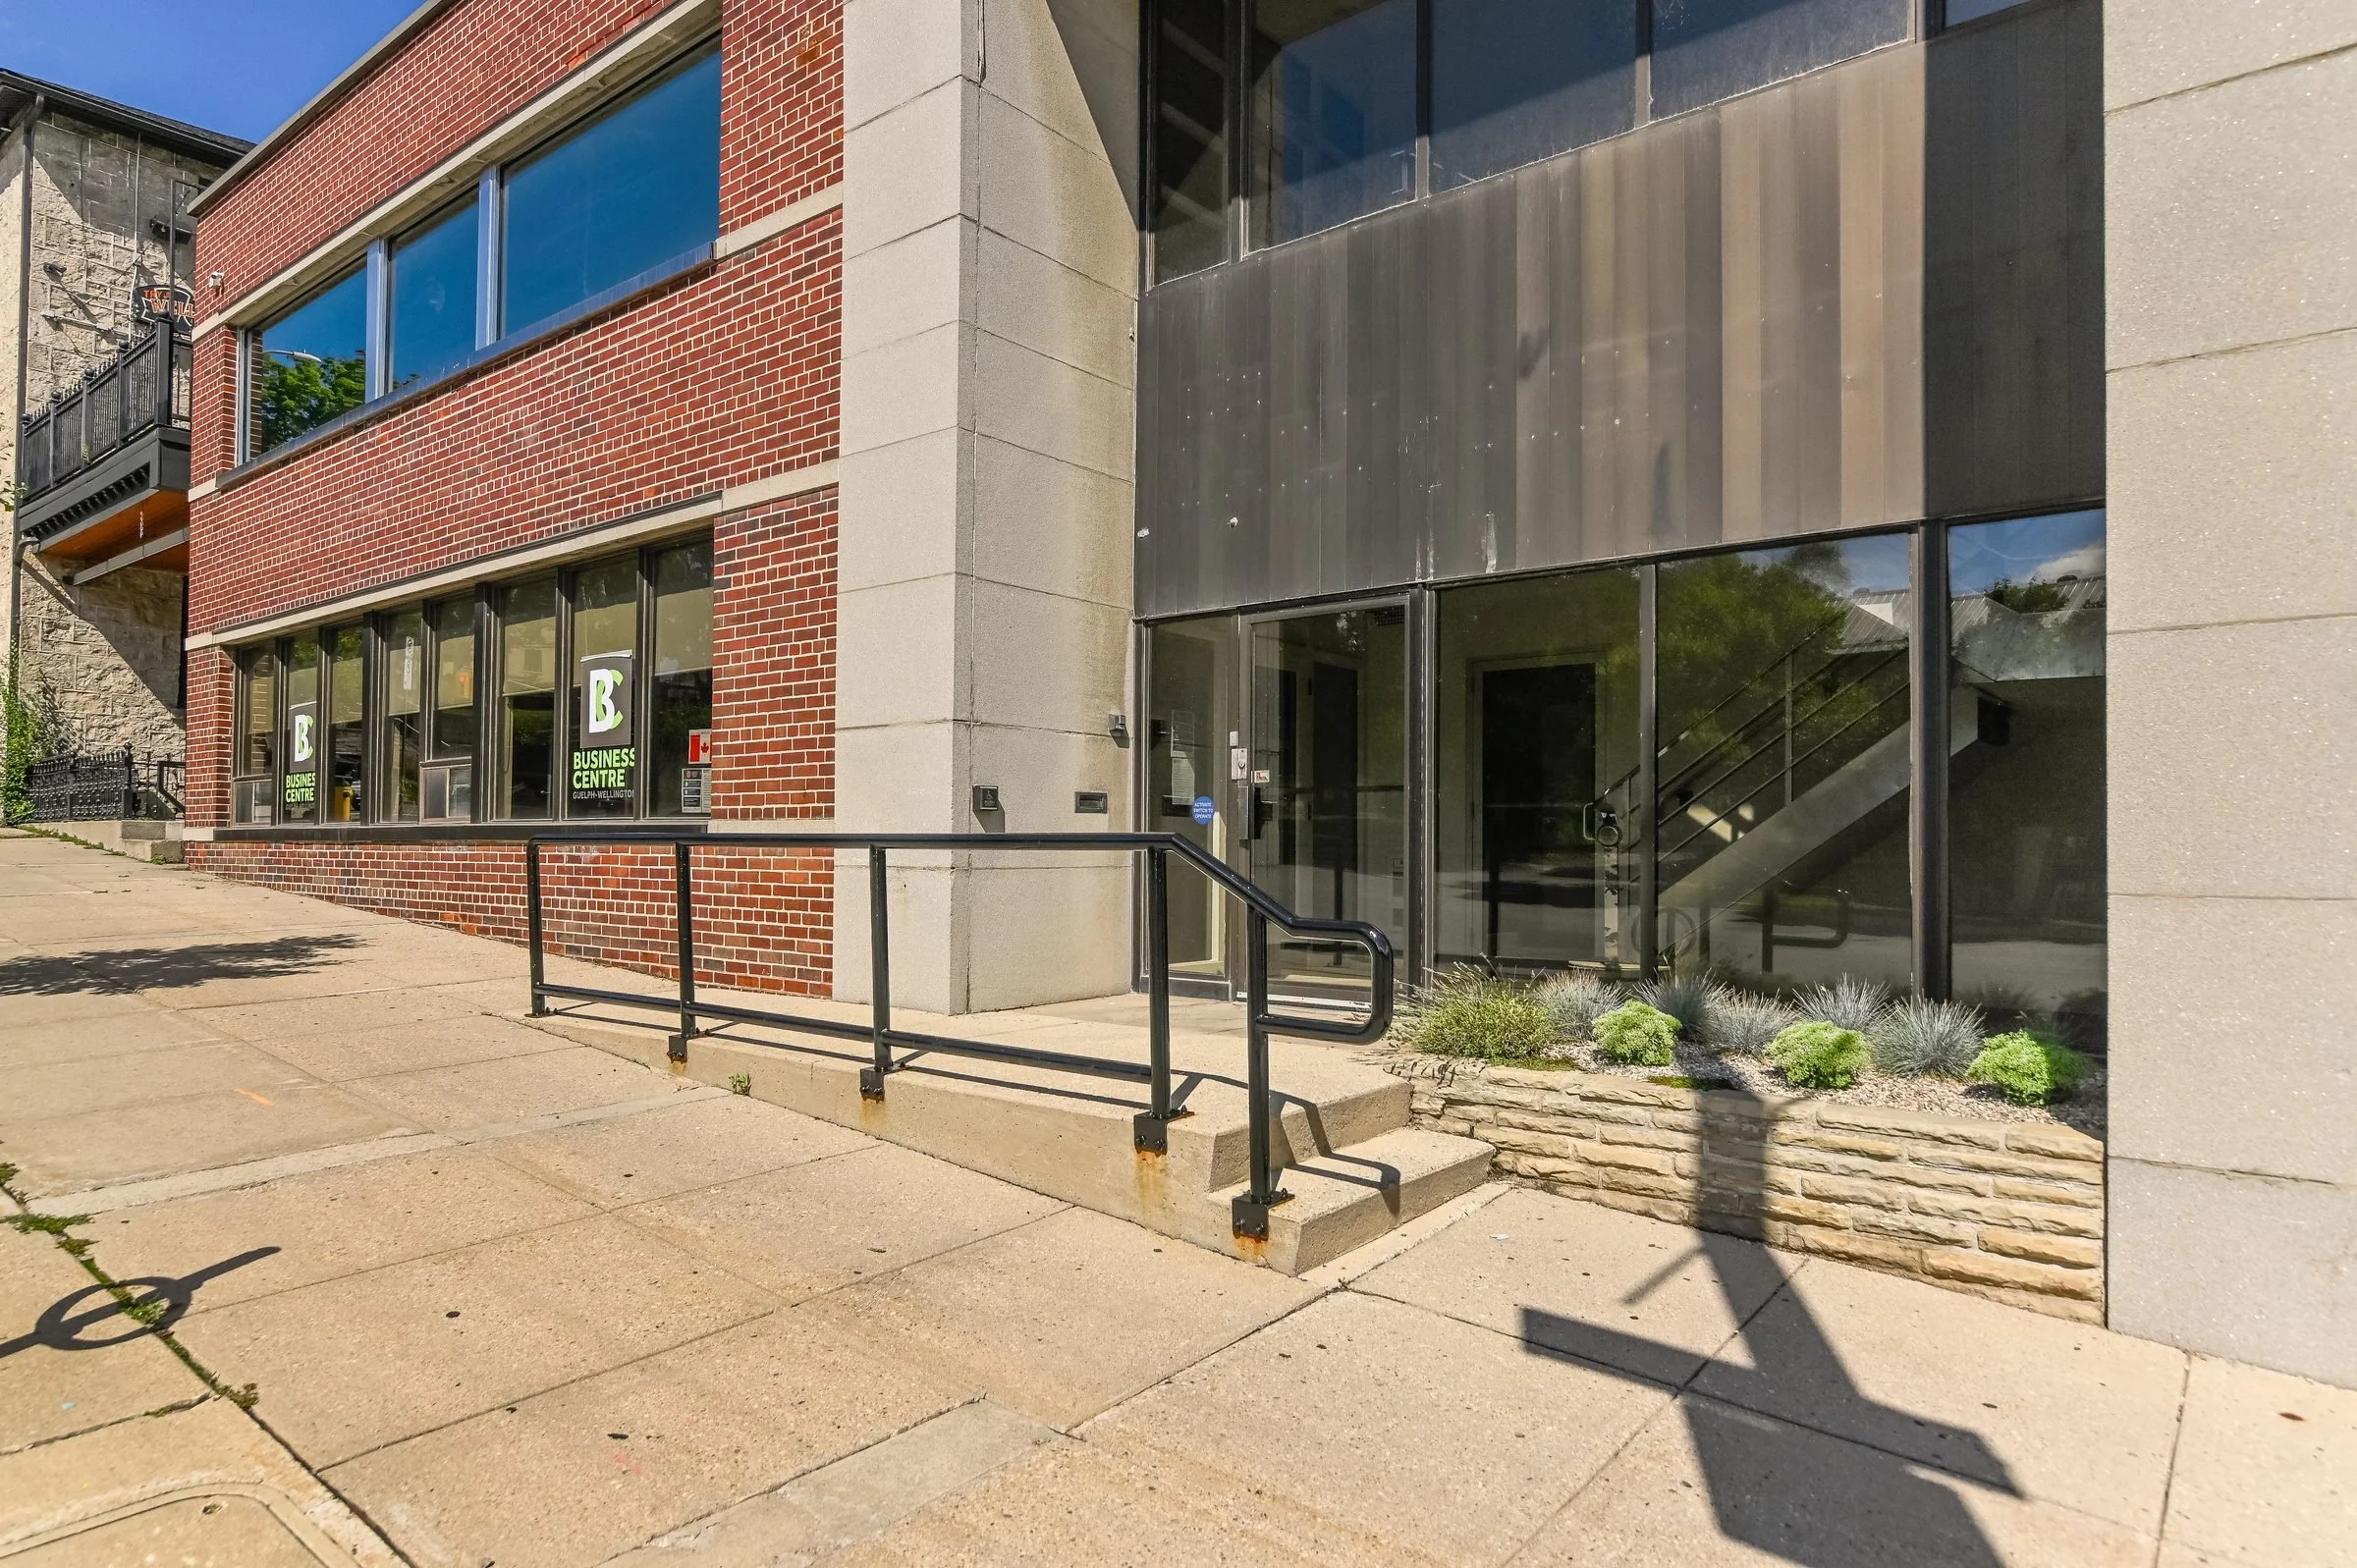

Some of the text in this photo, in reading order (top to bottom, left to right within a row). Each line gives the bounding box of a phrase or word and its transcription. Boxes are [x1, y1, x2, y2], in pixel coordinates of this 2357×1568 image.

[144, 290, 162, 298] TRY
[573, 747, 635, 770] BUSINESS
[573, 769, 626, 789] CENTRE
[285, 786, 315, 803] CENTRE
